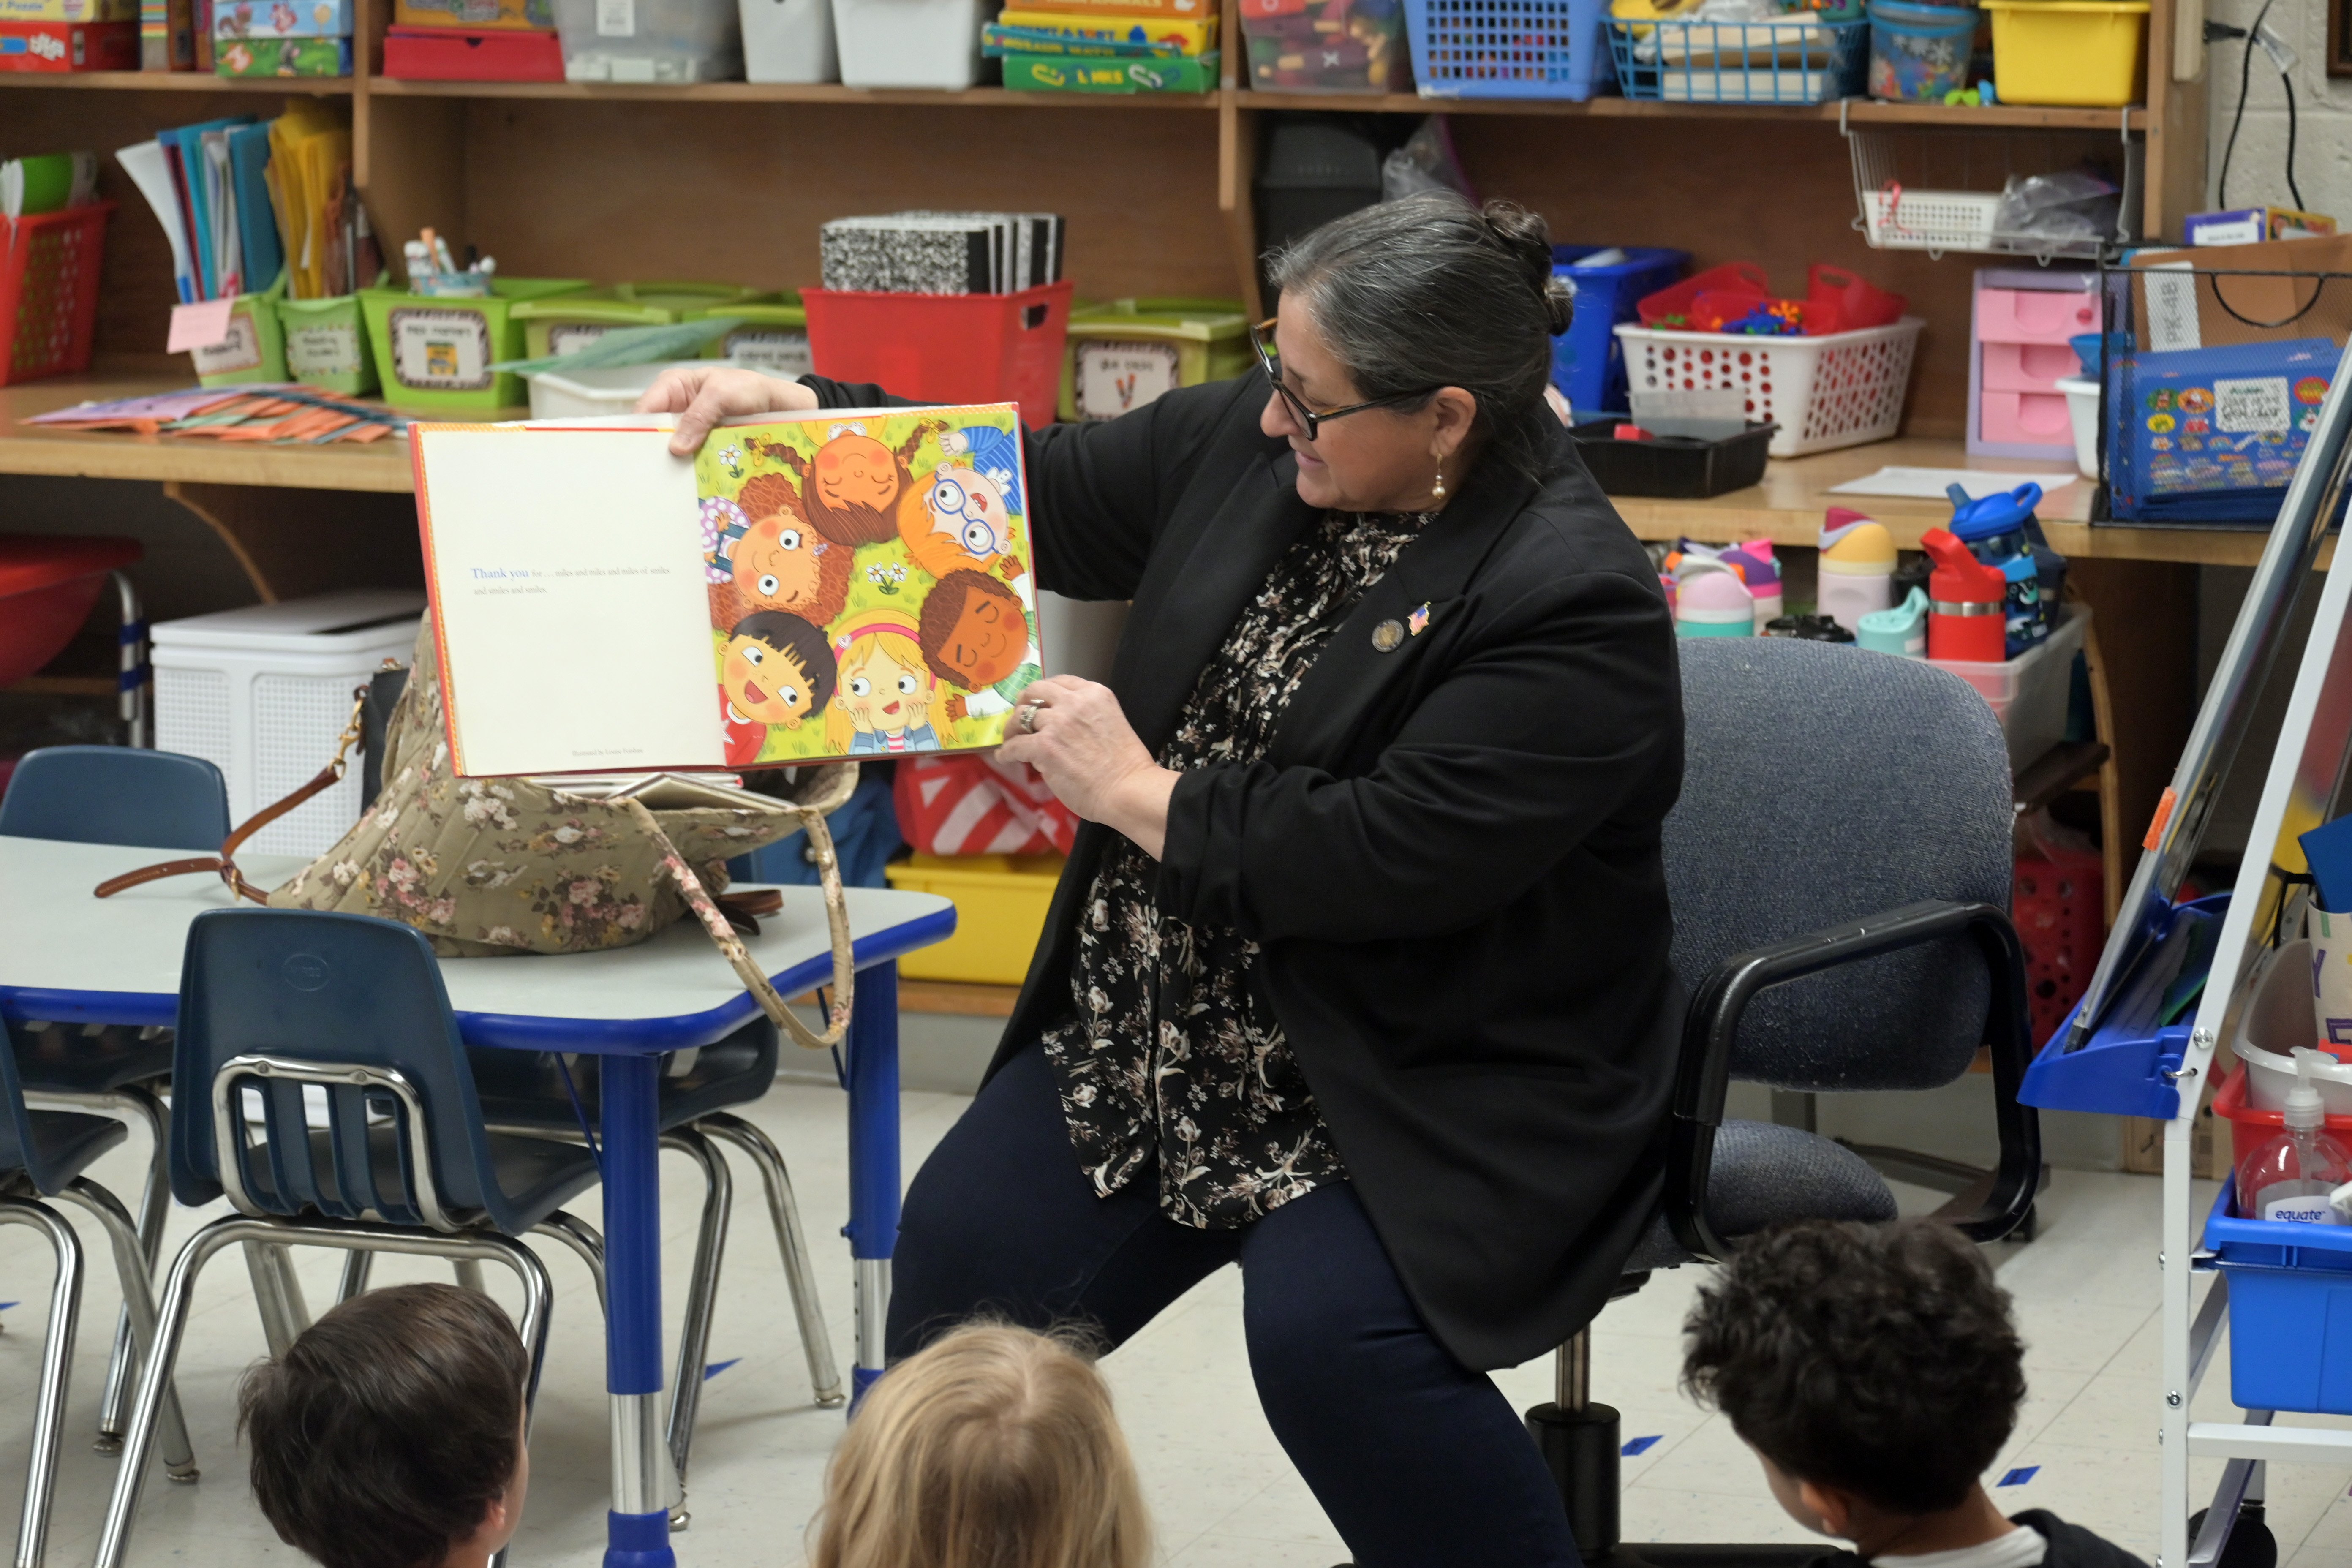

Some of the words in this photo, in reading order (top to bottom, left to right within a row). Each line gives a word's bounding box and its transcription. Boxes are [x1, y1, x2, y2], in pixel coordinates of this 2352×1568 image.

[470, 567, 507, 579] Thank
[509, 570, 529, 581] you
[555, 568, 573, 577] miles
[575, 567, 588, 576] and
[589, 567, 606, 576] miles
[608, 566, 620, 575] and
[621, 566, 639, 575] miles
[640, 566, 648, 574] of
[650, 565, 670, 574] smiles
[474, 586, 487, 595] and
[488, 586, 509, 595] smiles
[511, 585, 524, 594] and
